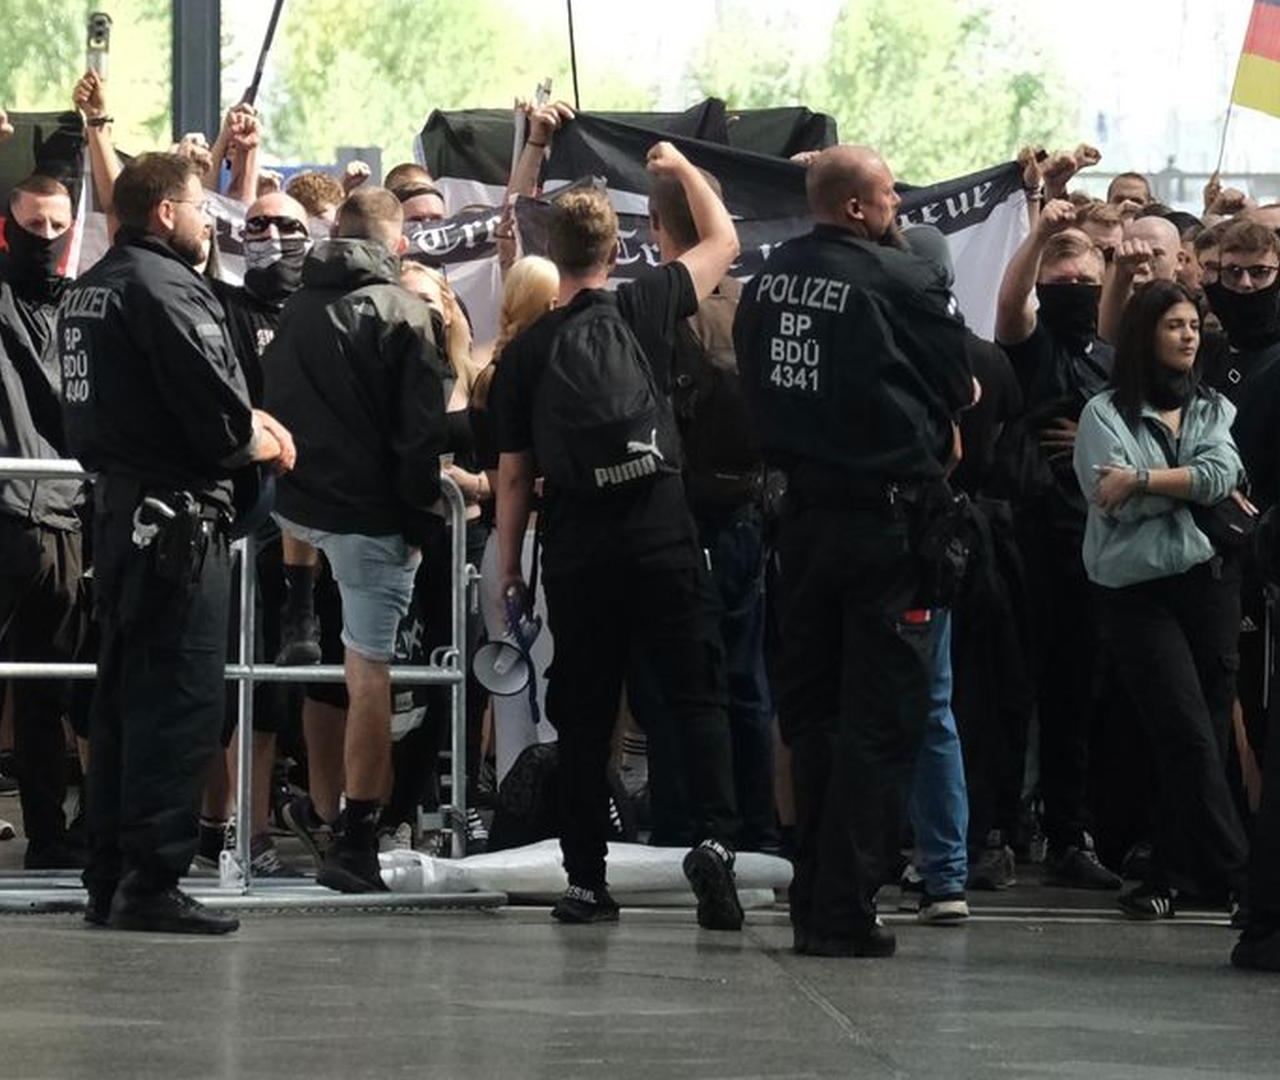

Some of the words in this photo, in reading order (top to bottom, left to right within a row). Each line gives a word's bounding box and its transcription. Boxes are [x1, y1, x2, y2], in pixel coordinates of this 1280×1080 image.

[756, 274, 850, 313] POLIZEI
[780, 312, 811, 336] BP
[770, 338, 819, 366] BDÜ
[770, 364, 818, 391] 4341
[594, 453, 657, 488] PUMA
